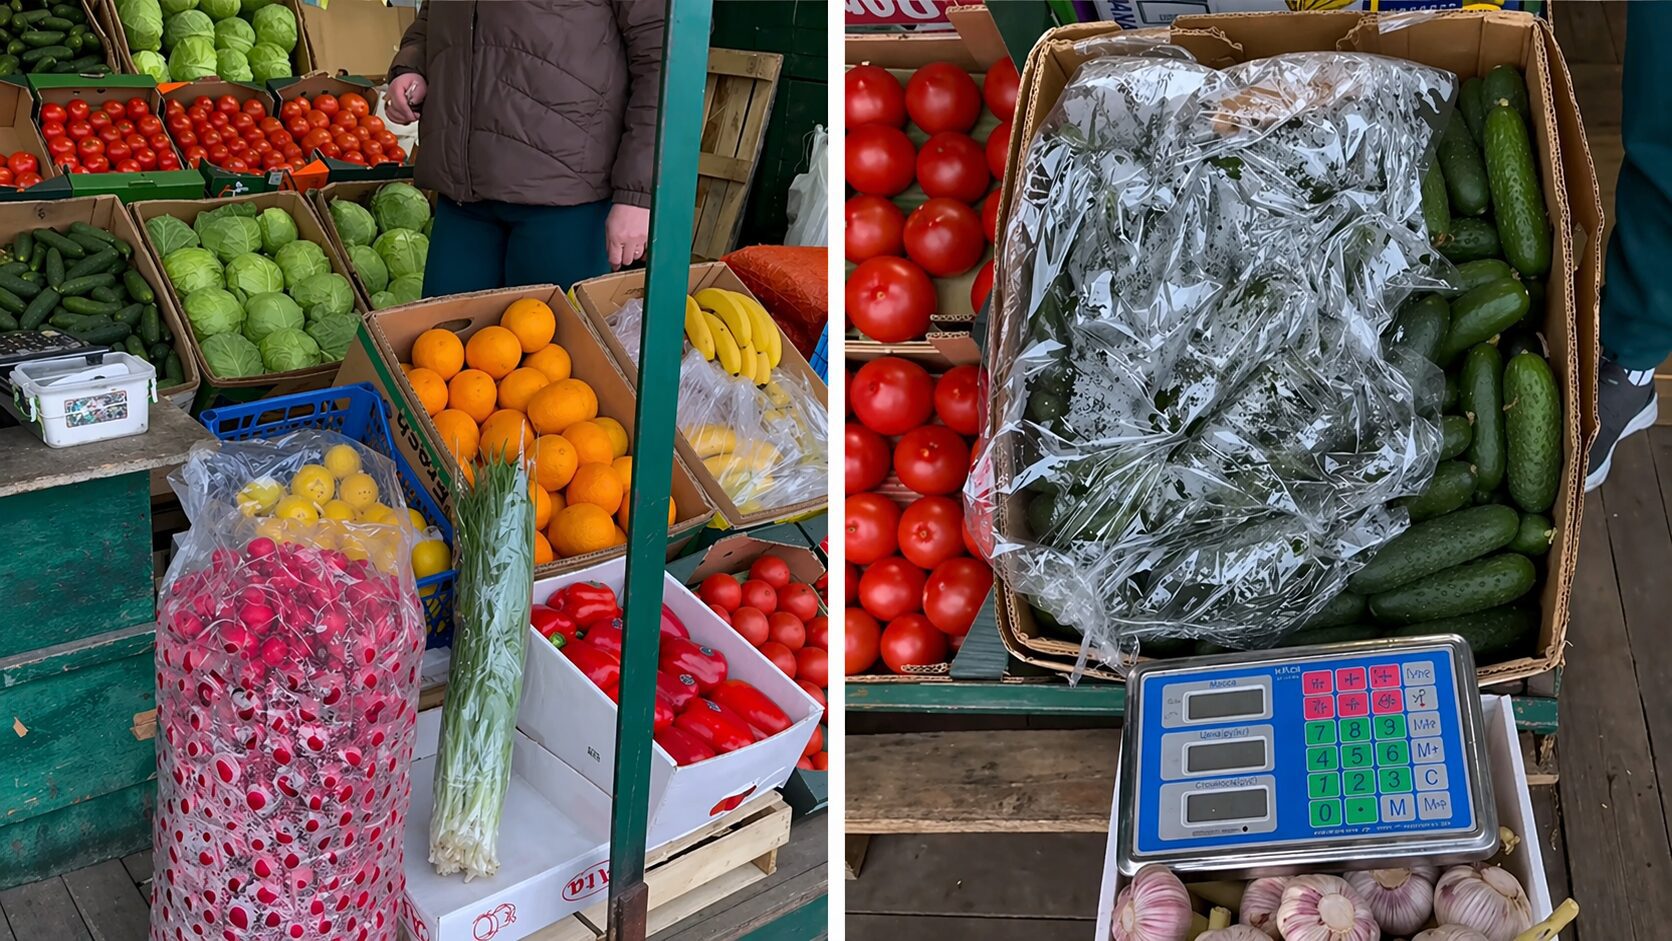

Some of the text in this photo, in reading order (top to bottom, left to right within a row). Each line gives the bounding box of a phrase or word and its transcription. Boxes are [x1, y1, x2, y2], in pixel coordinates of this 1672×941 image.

[1314, 725, 1326, 741] 7
[1349, 721, 1361, 739] 8
[1384, 718, 1396, 736] 9
[1316, 742, 1439, 767] 4 5 6 M+
[1319, 769, 1439, 793] 1 2 3 C
[1319, 803, 1332, 822] 0
[1390, 799, 1406, 816] M
